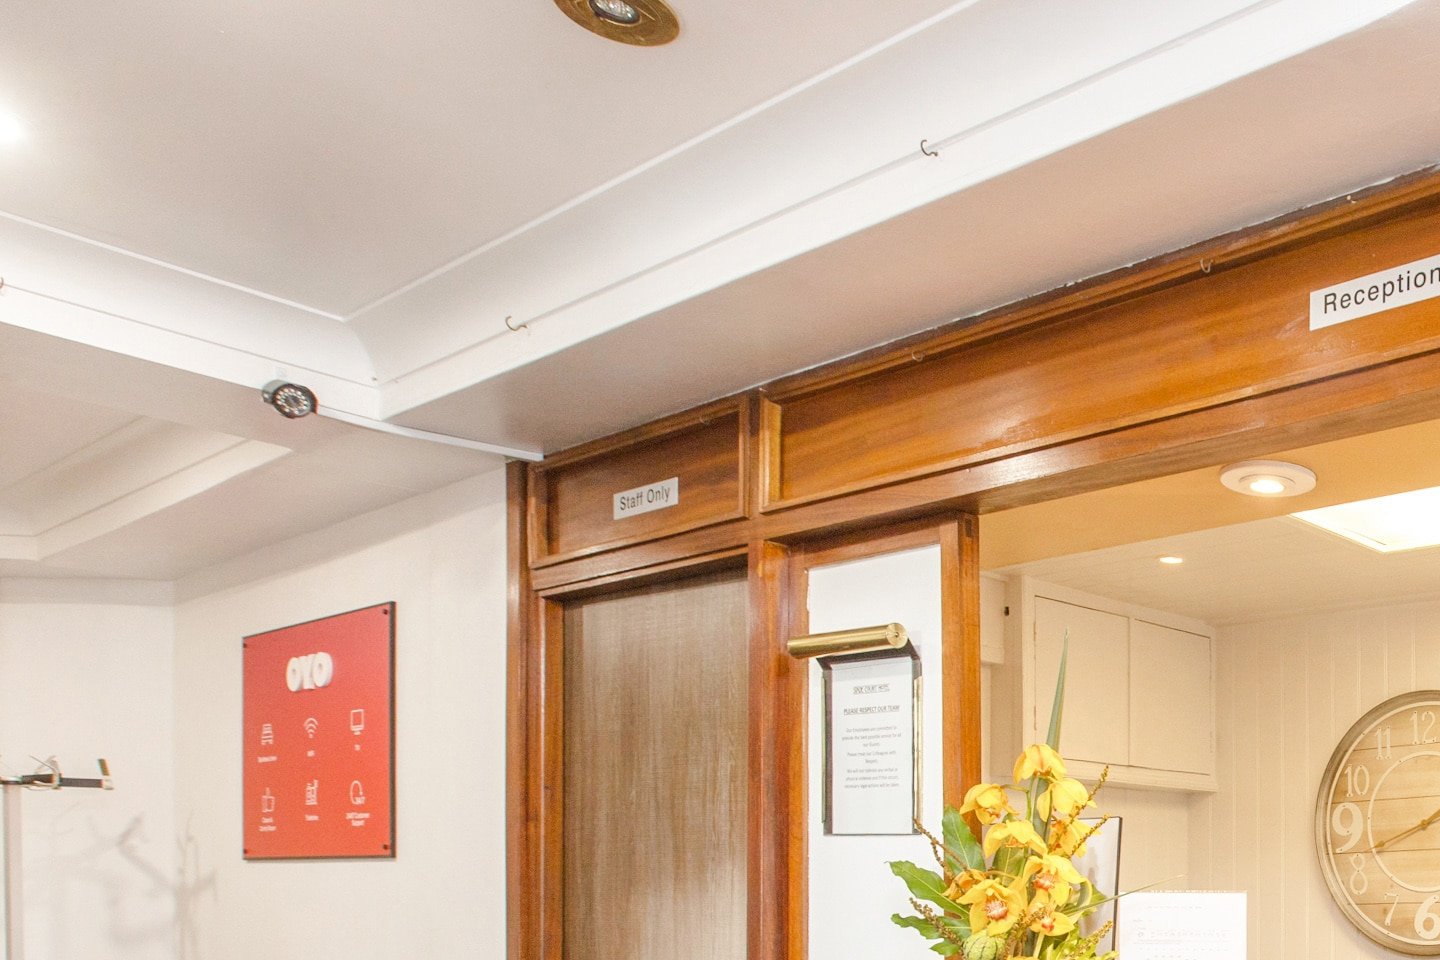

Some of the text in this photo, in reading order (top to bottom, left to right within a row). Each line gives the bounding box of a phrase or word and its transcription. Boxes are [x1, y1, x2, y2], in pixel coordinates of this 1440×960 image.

[620, 486, 670, 510] Staff Only
[286, 652, 333, 692] OYO
[1374, 727, 1392, 760] 11
[1409, 710, 1437, 744] 12
[1344, 764, 1370, 798] 10
[1331, 802, 1364, 853] 9
[1350, 853, 1368, 895] 8
[1384, 893, 1400, 926] 7
